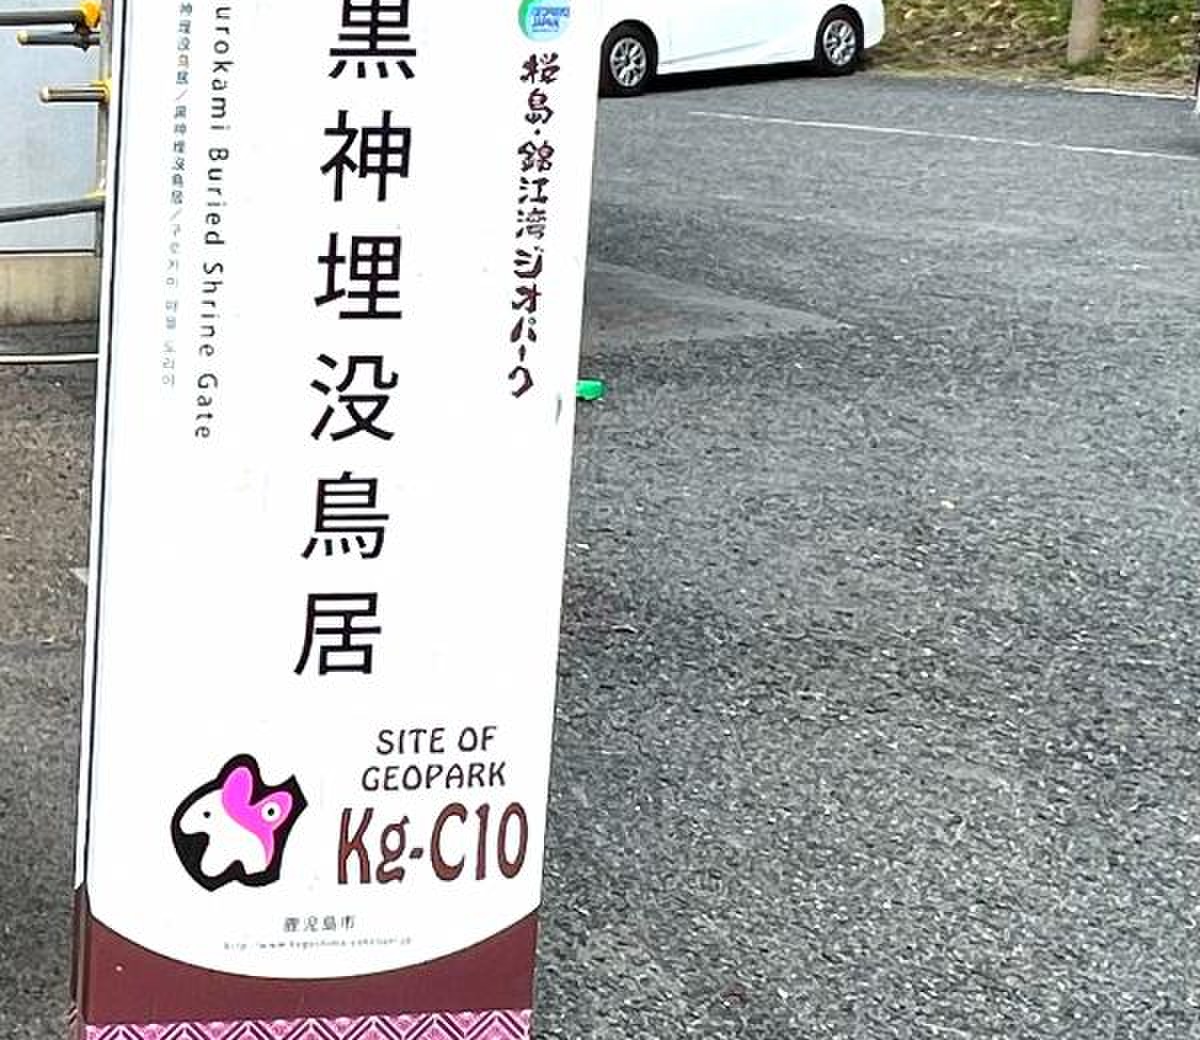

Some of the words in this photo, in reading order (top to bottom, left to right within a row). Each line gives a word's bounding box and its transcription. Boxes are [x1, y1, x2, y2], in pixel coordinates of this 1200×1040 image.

[203, 147, 230, 246] Buried
[199, 261, 224, 358] Shrine
[194, 372, 219, 439] Gate
[361, 760, 507, 792] GEOPARK
[376, 727, 446, 756] SITE
[457, 725, 498, 752] OF
[337, 801, 529, 885] Kg-C10
